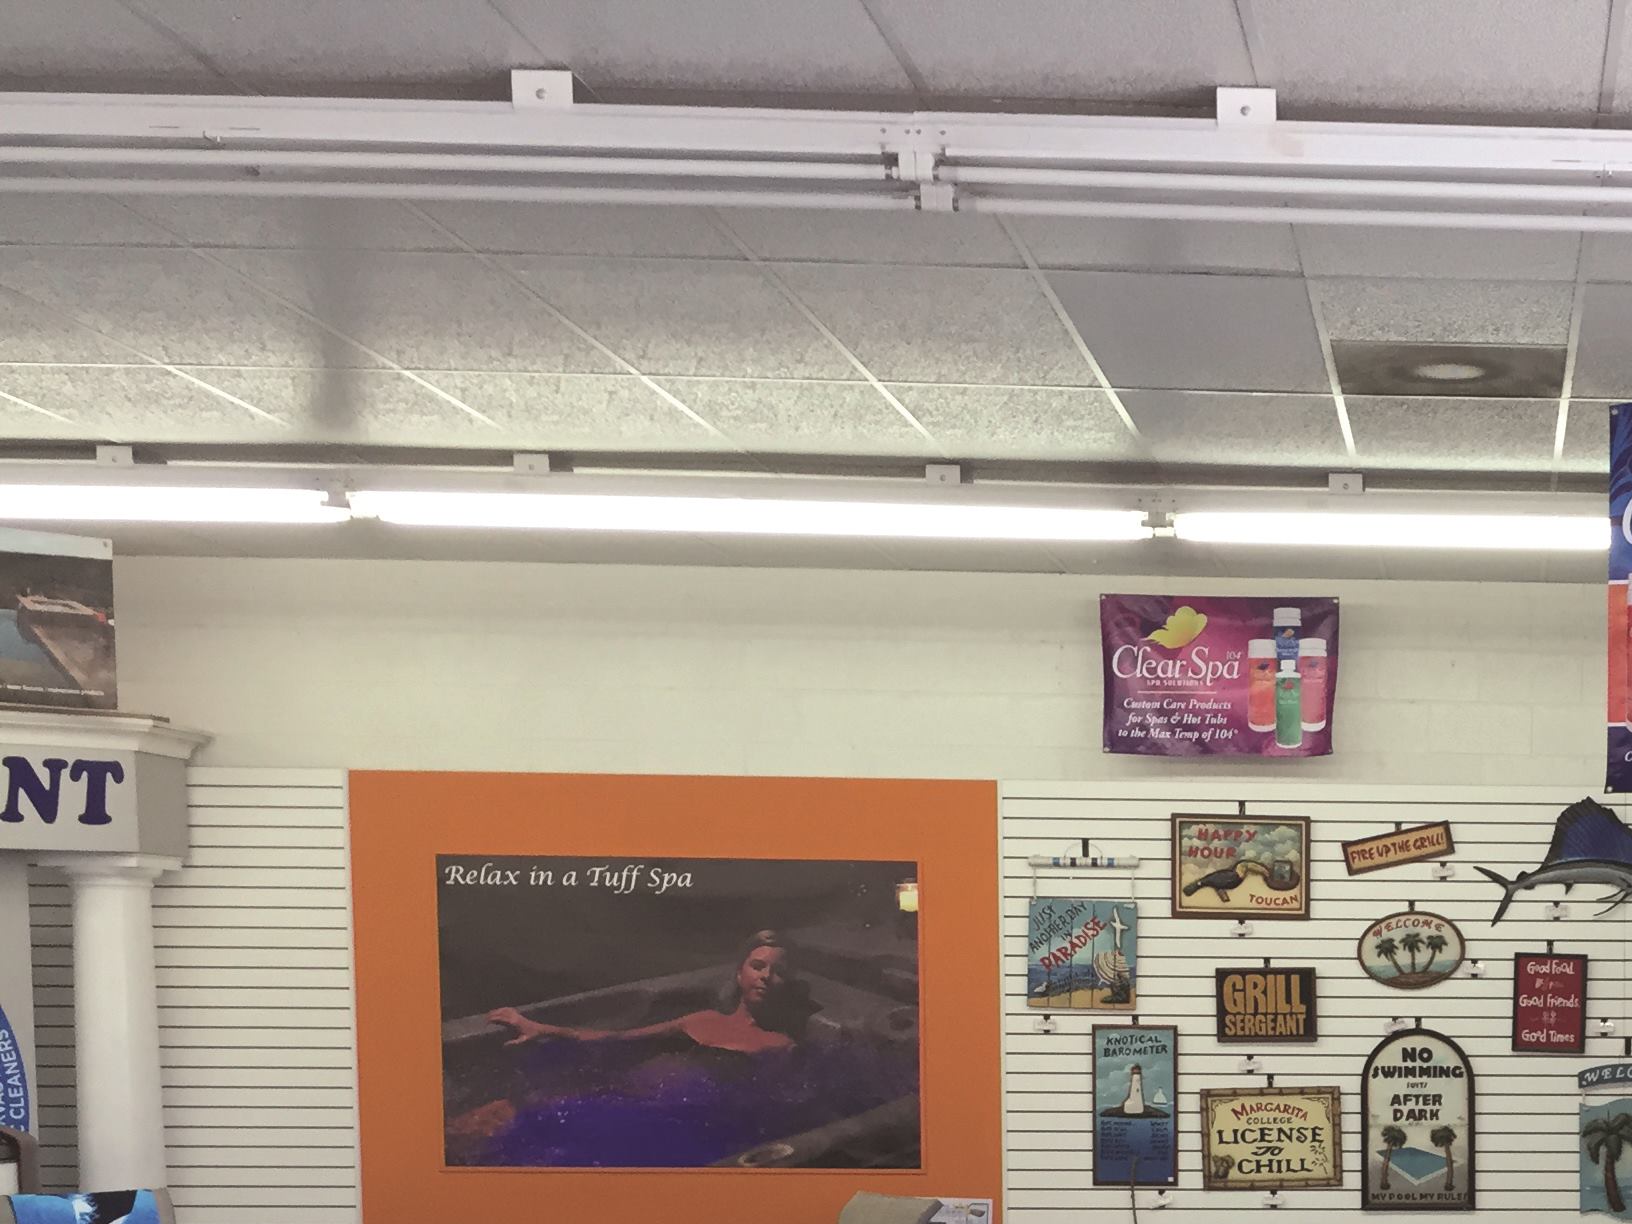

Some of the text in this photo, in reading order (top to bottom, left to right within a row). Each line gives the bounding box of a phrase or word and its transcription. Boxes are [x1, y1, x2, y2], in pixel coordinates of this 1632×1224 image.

[1123, 698, 1232, 709] Custom Care Products
[1126, 712, 1227, 726] for Spas & Hot Tubs
[1118, 729, 1128, 738] to
[1130, 729, 1148, 738] the
[1149, 729, 1171, 738] Max
[1174, 729, 1199, 741] Temp
[1201, 728, 1214, 742] of
[1197, 828, 1257, 842] HAPPY
[1188, 846, 1237, 859] HOUR
[1350, 832, 1445, 864] FIRE UP THE GRILL!
[444, 863, 694, 895] Relax in a Tuff Spa
[1249, 893, 1299, 906] TOUCAN
[1033, 903, 1056, 931] JUST
[1029, 901, 1088, 953] ANOTHER DAY
[1372, 918, 1445, 937] WELCOME
[1060, 930, 1072, 941] IN
[1040, 916, 1108, 972] PARADISE
[1527, 960, 1575, 974] Good Food
[1223, 974, 1306, 1013] GRILL
[1519, 994, 1544, 1007] Good
[1225, 1014, 1306, 1036] SERGEANT
[1106, 1034, 1162, 1046] KNOTICAL
[1521, 1028, 1575, 1043] Good Times
[1103, 1045, 1168, 1057] BAROMETER
[1402, 1047, 1433, 1063] NO
[1, 1029, 25, 1120] CLEANERS
[1372, 1066, 1464, 1079] SWIMMING
[1390, 1093, 1443, 1106] AFTER
[1231, 1102, 1308, 1121] MARGARITA
[1393, 1108, 1440, 1122] DARK
[1246, 1116, 1294, 1125] COLLEGE
[1216, 1126, 1324, 1145] LICENSE
[1237, 1158, 1313, 1174] CHILL
[1437, 1192, 1469, 1200] RULES
